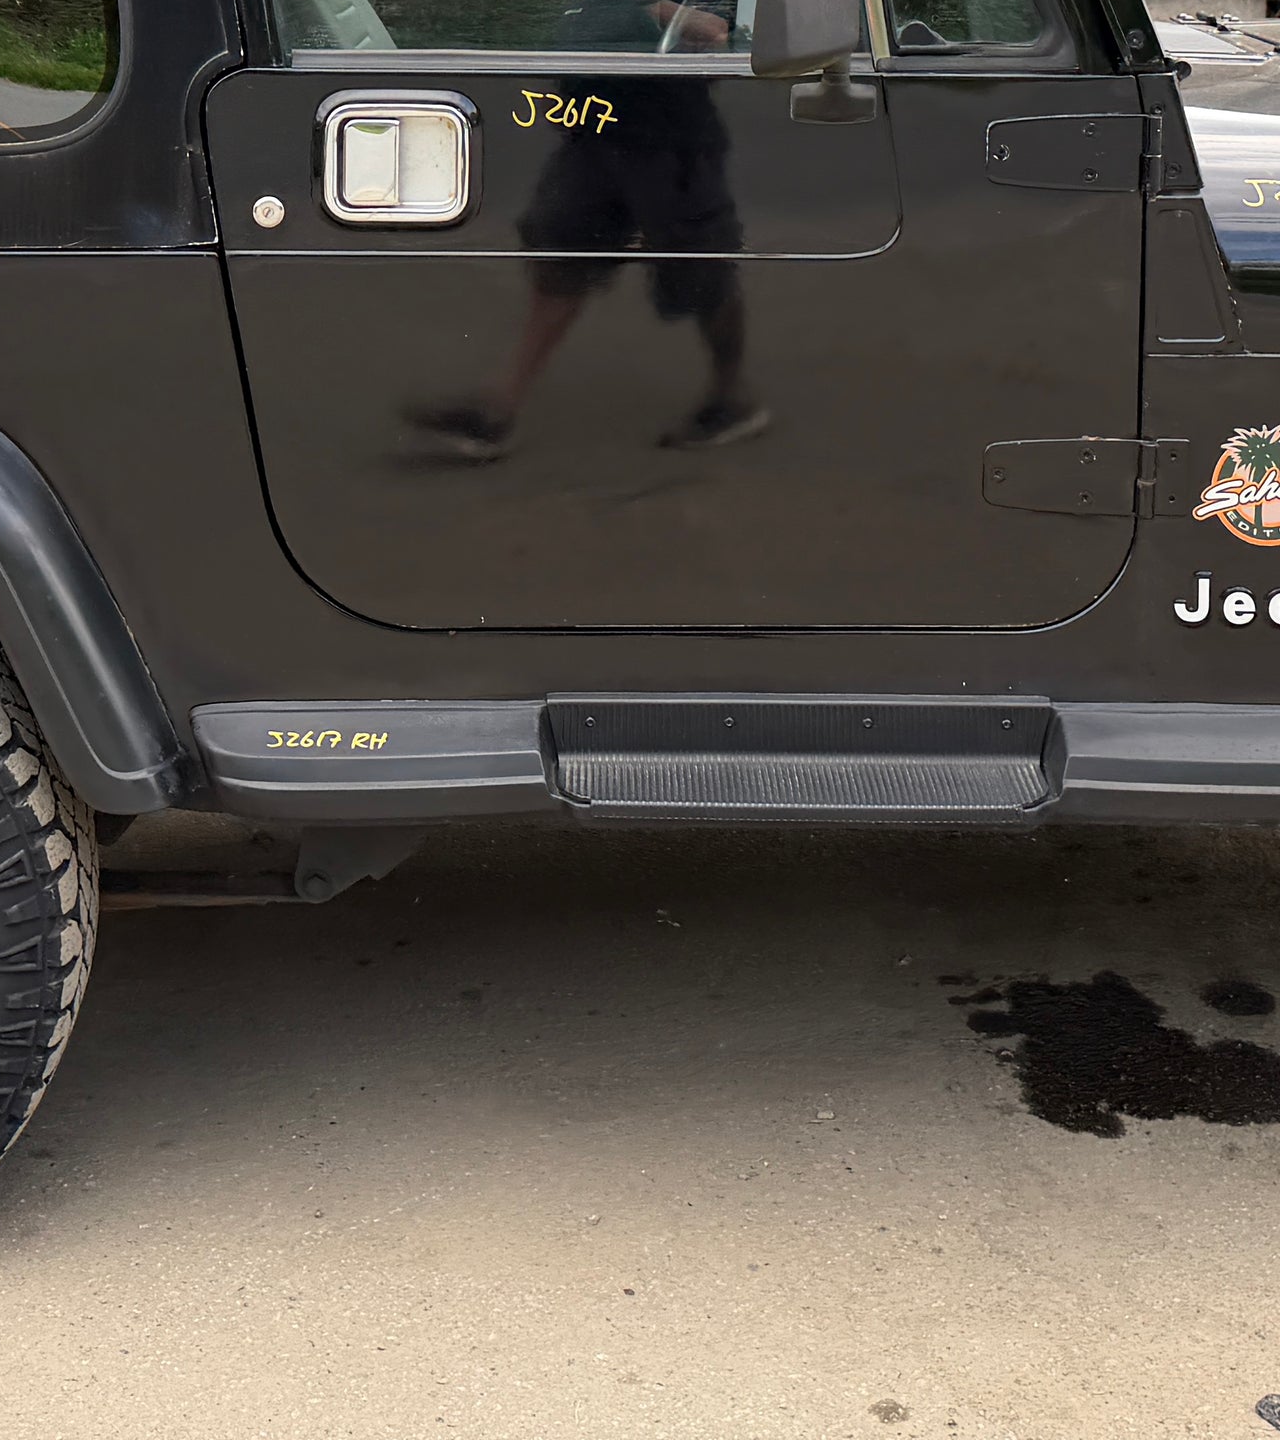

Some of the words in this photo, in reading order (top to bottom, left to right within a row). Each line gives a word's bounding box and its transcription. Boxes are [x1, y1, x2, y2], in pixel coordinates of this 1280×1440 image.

[512, 89, 618, 134] J2617
[266, 731, 342, 749] J2617
[350, 732, 389, 750] RH
